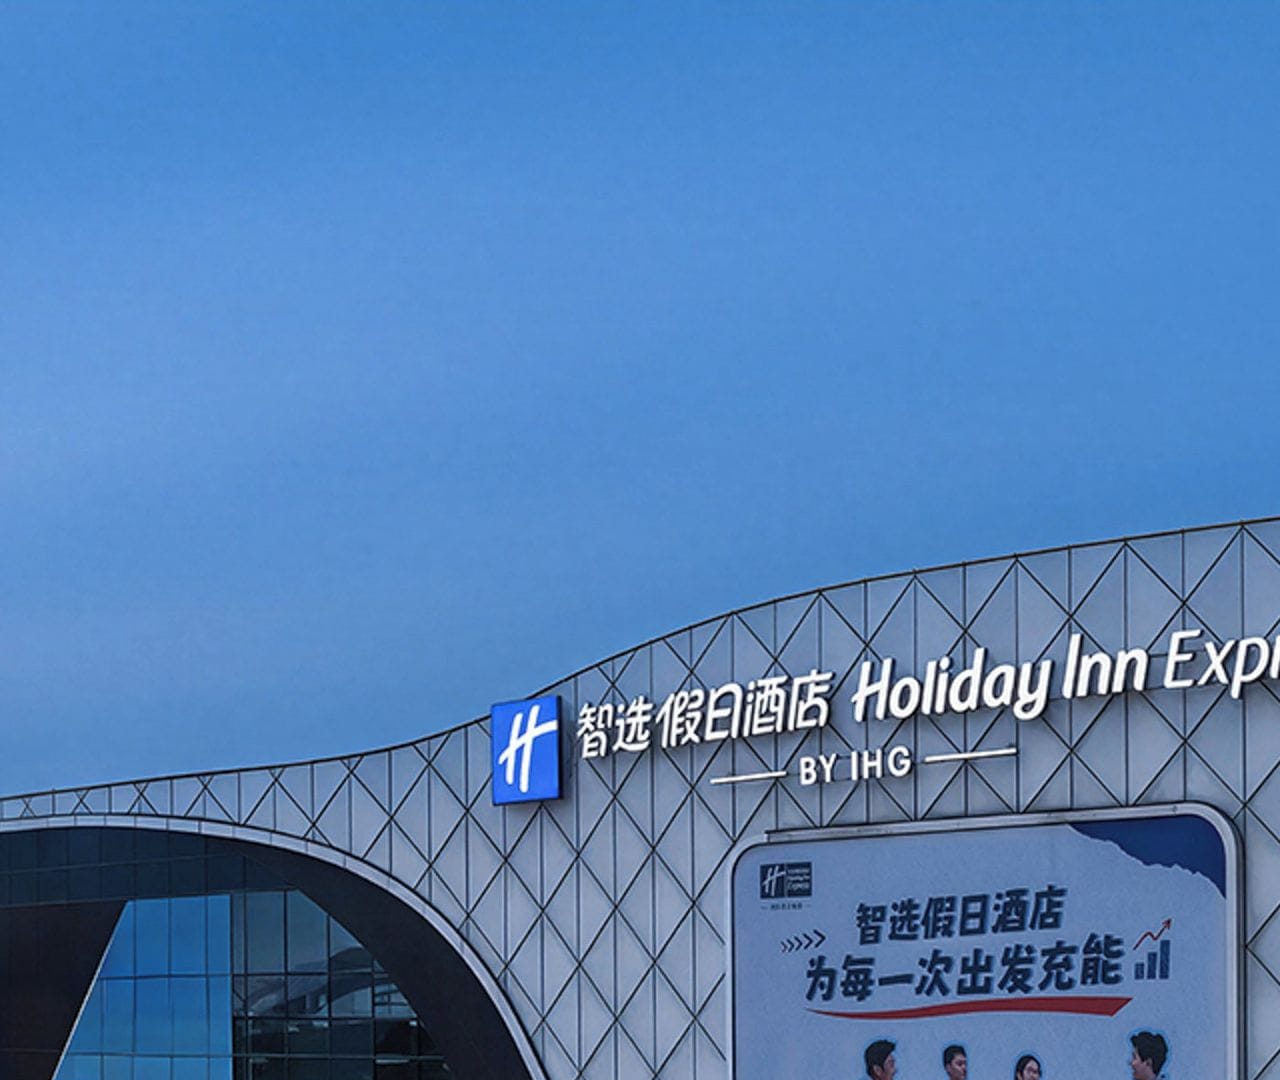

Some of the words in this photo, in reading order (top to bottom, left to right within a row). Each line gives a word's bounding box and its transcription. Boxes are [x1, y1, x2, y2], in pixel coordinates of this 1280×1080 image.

[577, 671, 833, 759] 智选假日酒店
[851, 647, 1053, 722] Holiday
[1062, 633, 1149, 699] Inn
[799, 753, 837, 785] BY
[851, 746, 911, 781] IHG
[855, 884, 1067, 945] 智选假日酒店
[805, 933, 1125, 1001] 为每一次出发充能
